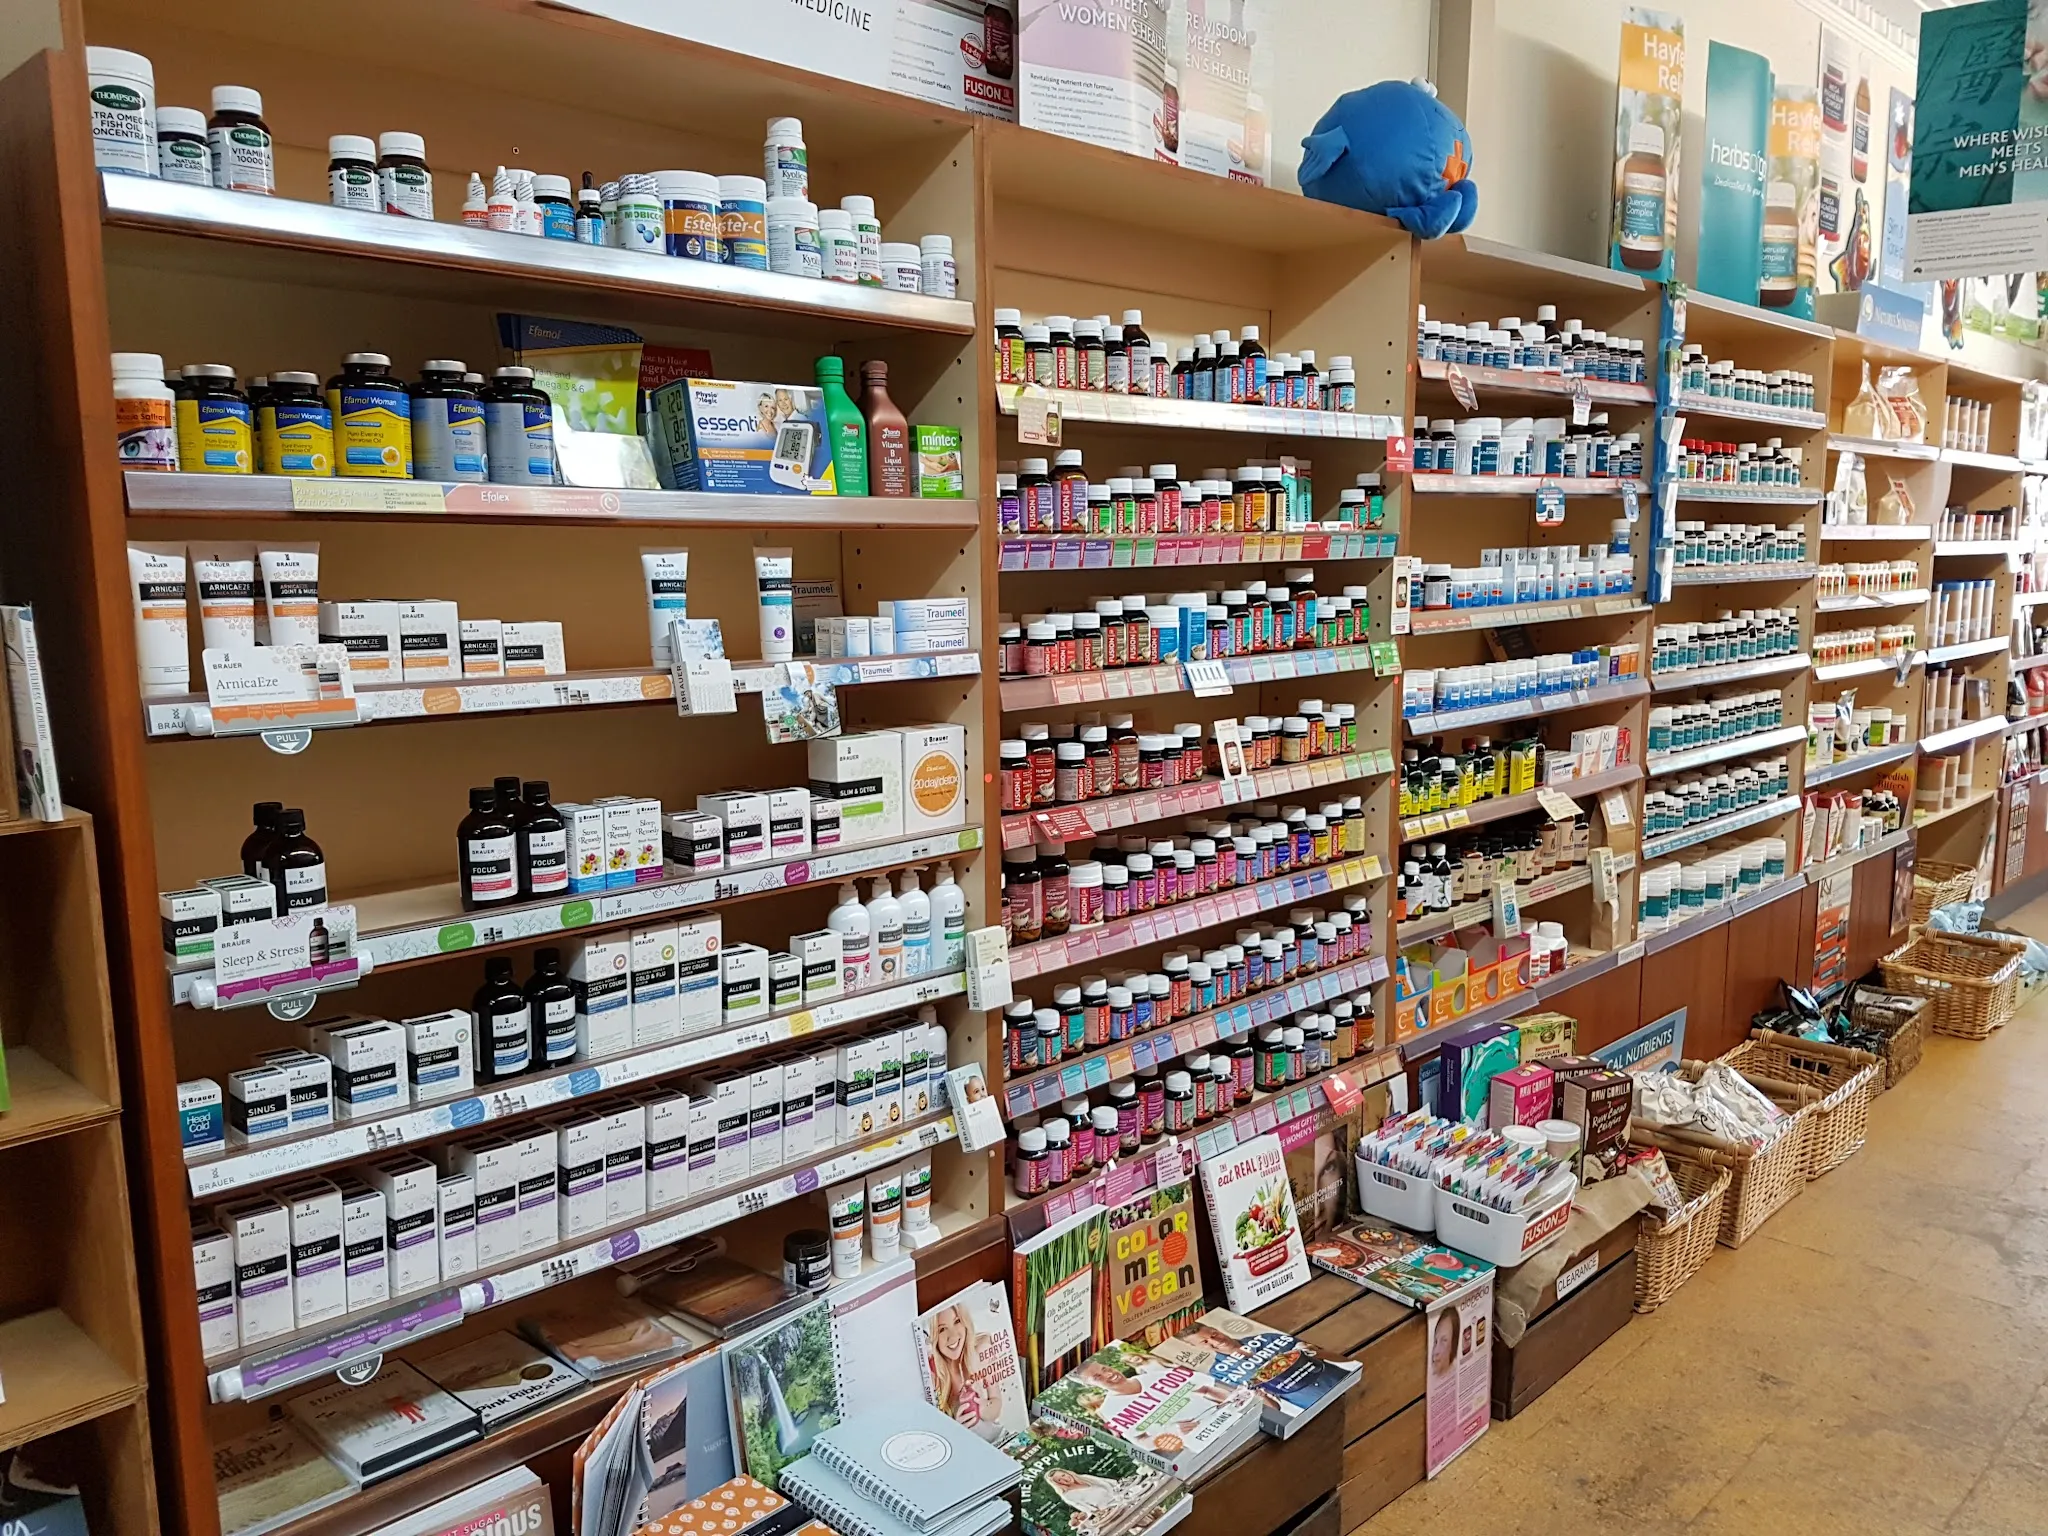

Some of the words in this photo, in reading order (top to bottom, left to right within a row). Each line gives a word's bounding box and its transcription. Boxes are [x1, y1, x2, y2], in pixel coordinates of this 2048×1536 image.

[1058, 4, 1141, 36] WOMEN'S
[1140, 22, 1166, 53] HEALTH
[1202, 16, 1247, 45] WISDOM
[1187, 33, 1221, 56] MEETS
[1212, 62, 1250, 85] HEALTH
[965, 79, 1001, 99] FUSION
[1060, 78, 1081, 87] nutrient
[1082, 80, 1092, 88] rich
[1093, 82, 1114, 91] formula
[101, 119, 123, 128] FISH
[125, 122, 141, 132] OIL
[93, 127, 153, 144] ONCENTRATE
[1954, 130, 2008, 148] WHERE
[1991, 141, 2041, 159] MEETS
[1959, 161, 2007, 178] MEN'S
[1627, 196, 1656, 210] Quercetin
[1627, 206, 1653, 217] Complex
[528, 325, 561, 340] Efamol
[553, 371, 571, 379] and
[672, 365, 709, 377] Arteries
[344, 396, 369, 405] Efamol
[371, 397, 397, 406] Woman
[695, 391, 718, 399] Physio
[453, 404, 478, 414] Efamol
[668, 391, 681, 414] 120
[279, 412, 300, 420] Efamol
[300, 413, 323, 421] Woman
[673, 417, 686, 443] 80
[881, 441, 903, 449] Vitamin
[884, 456, 902, 466] Liquid
[481, 492, 510, 502] Efolex
[209, 583, 250, 592] ARNICAEZE
[926, 605, 965, 619] Traumeel
[344, 638, 379, 647] ARNICAEZE
[464, 642, 496, 650] ARNICAEZE
[927, 635, 965, 648] Traumeel
[212, 662, 243, 670] BRAUER
[861, 664, 893, 676] Traumeel
[216, 675, 279, 691] ArnicaEze
[677, 664, 686, 702] BRAUER
[158, 721, 186, 730] BRAU
[276, 733, 300, 743] PULL
[929, 735, 949, 744] Brauer
[839, 753, 859, 762] BRAUER
[1877, 772, 1909, 781] Swedish
[839, 787, 854, 797] SLIM
[860, 785, 877, 794] DETOX
[730, 830, 748, 839] SLEEP
[473, 865, 497, 874] FOCUS
[289, 877, 313, 886] BRAUER
[176, 925, 200, 936] CALM
[222, 938, 251, 949] BRAUER
[222, 954, 254, 970] Sleep
[256, 951, 266, 962] &
[270, 945, 305, 961] Stress
[680, 965, 690, 973] DRY
[691, 960, 709, 970] COUGH
[807, 964, 835, 975] HAYFEVER
[635, 974, 650, 982] COLD
[655, 971, 666, 979] FLU
[588, 983, 608, 992] CHESTY
[608, 979, 627, 988] COUGH
[729, 983, 753, 993] ALLERGY
[281, 1000, 304, 1011] PULL
[495, 1040, 505, 1048] DRY
[507, 1036, 525, 1046] COUGH
[1625, 1029, 1673, 1066] NUTRIENTS
[352, 1074, 369, 1083] SORE
[370, 1069, 392, 1080] THROAT
[188, 1093, 216, 1103] Brauer
[290, 1091, 318, 1102] SINUS
[248, 1104, 276, 1116] SINUS
[787, 1102, 806, 1111] REFLUX
[187, 1112, 211, 1125] Head
[752, 1108, 772, 1119] ECZEMA
[188, 1120, 210, 1132] Cold
[1286, 1127, 1312, 1144] WOMEN'S
[608, 1154, 630, 1165] COUGH
[1217, 1172, 1233, 1188] eat
[1234, 1160, 1256, 1180] REAL
[1256, 1150, 1281, 1173] FOOD
[1260, 1164, 1281, 1178] COOKBOOK
[198, 1176, 235, 1191] BRAUER
[1029, 1169, 1037, 1192] FUSION
[479, 1196, 498, 1207] CALM
[1522, 1213, 1558, 1244] FUSION
[298, 1246, 322, 1258] SLEEP
[349, 1244, 375, 1256] TEETHING
[242, 1267, 266, 1278] COLIC
[1316, 1258, 1331, 1269] Raw
[1336, 1266, 1359, 1282] Simple
[1558, 1258, 1598, 1292] CLEARANCE
[1256, 1282, 1271, 1297] DAVID
[1271, 1272, 1295, 1291] GILLESPIE
[1063, 1287, 1074, 1299] The
[1053, 1300, 1084, 1324] Cookbook
[989, 1329, 1008, 1345] LOLA
[979, 1340, 1011, 1362] BERRY'S
[1215, 1353, 1243, 1372] ONE
[1239, 1334, 1267, 1352] POT
[970, 1357, 1014, 1383] SMOOTHIES
[991, 1368, 1015, 1387] JUICES
[477, 1398, 507, 1413] Pink
[509, 1374, 572, 1401] Ribbons,
[526, 1389, 549, 1401] Inc.
[1109, 1393, 1160, 1435] FAMILY
[1159, 1367, 1194, 1397] FOOD
[1195, 1426, 1212, 1442] PETE
[1209, 1411, 1232, 1432] EVANS
[1067, 1444, 1096, 1458] LIFE
[1023, 1453, 1061, 1487] HAPPY
[1022, 1482, 1032, 1503] THE
[464, 1512, 501, 1534] SUGAR
